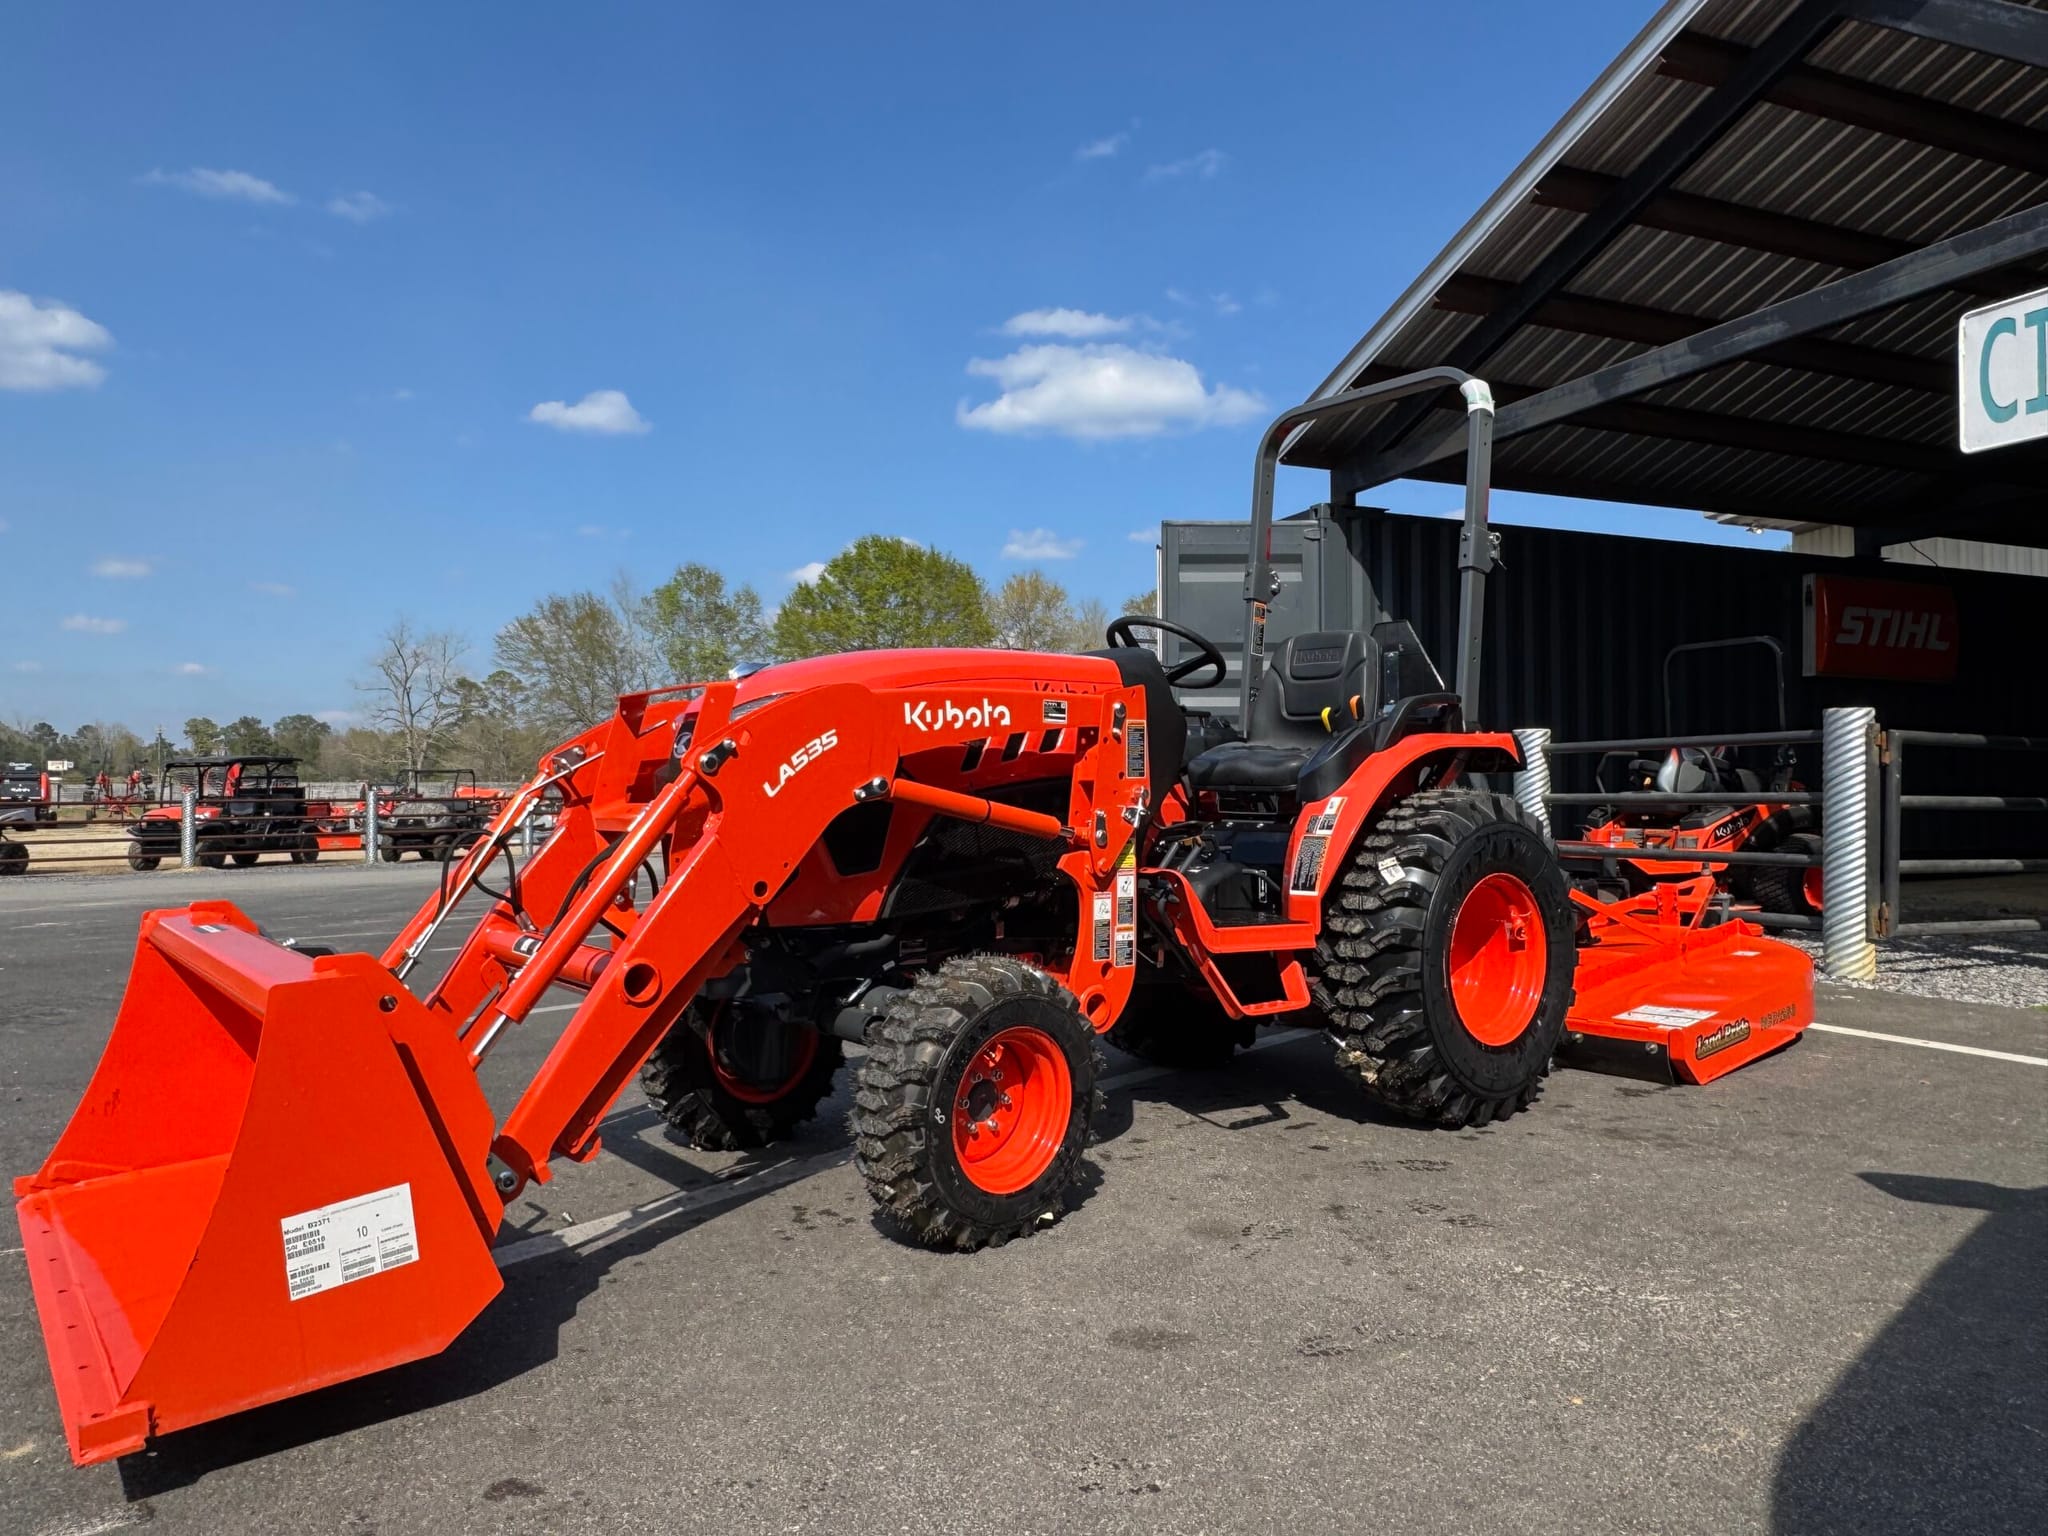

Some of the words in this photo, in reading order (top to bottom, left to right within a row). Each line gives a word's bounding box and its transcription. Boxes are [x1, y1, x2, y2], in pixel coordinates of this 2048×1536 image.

[1835, 606, 1950, 651] STIHL
[904, 698, 1011, 731] Kubota
[762, 729, 838, 797] LA535
[357, 1226, 368, 1238] 10
